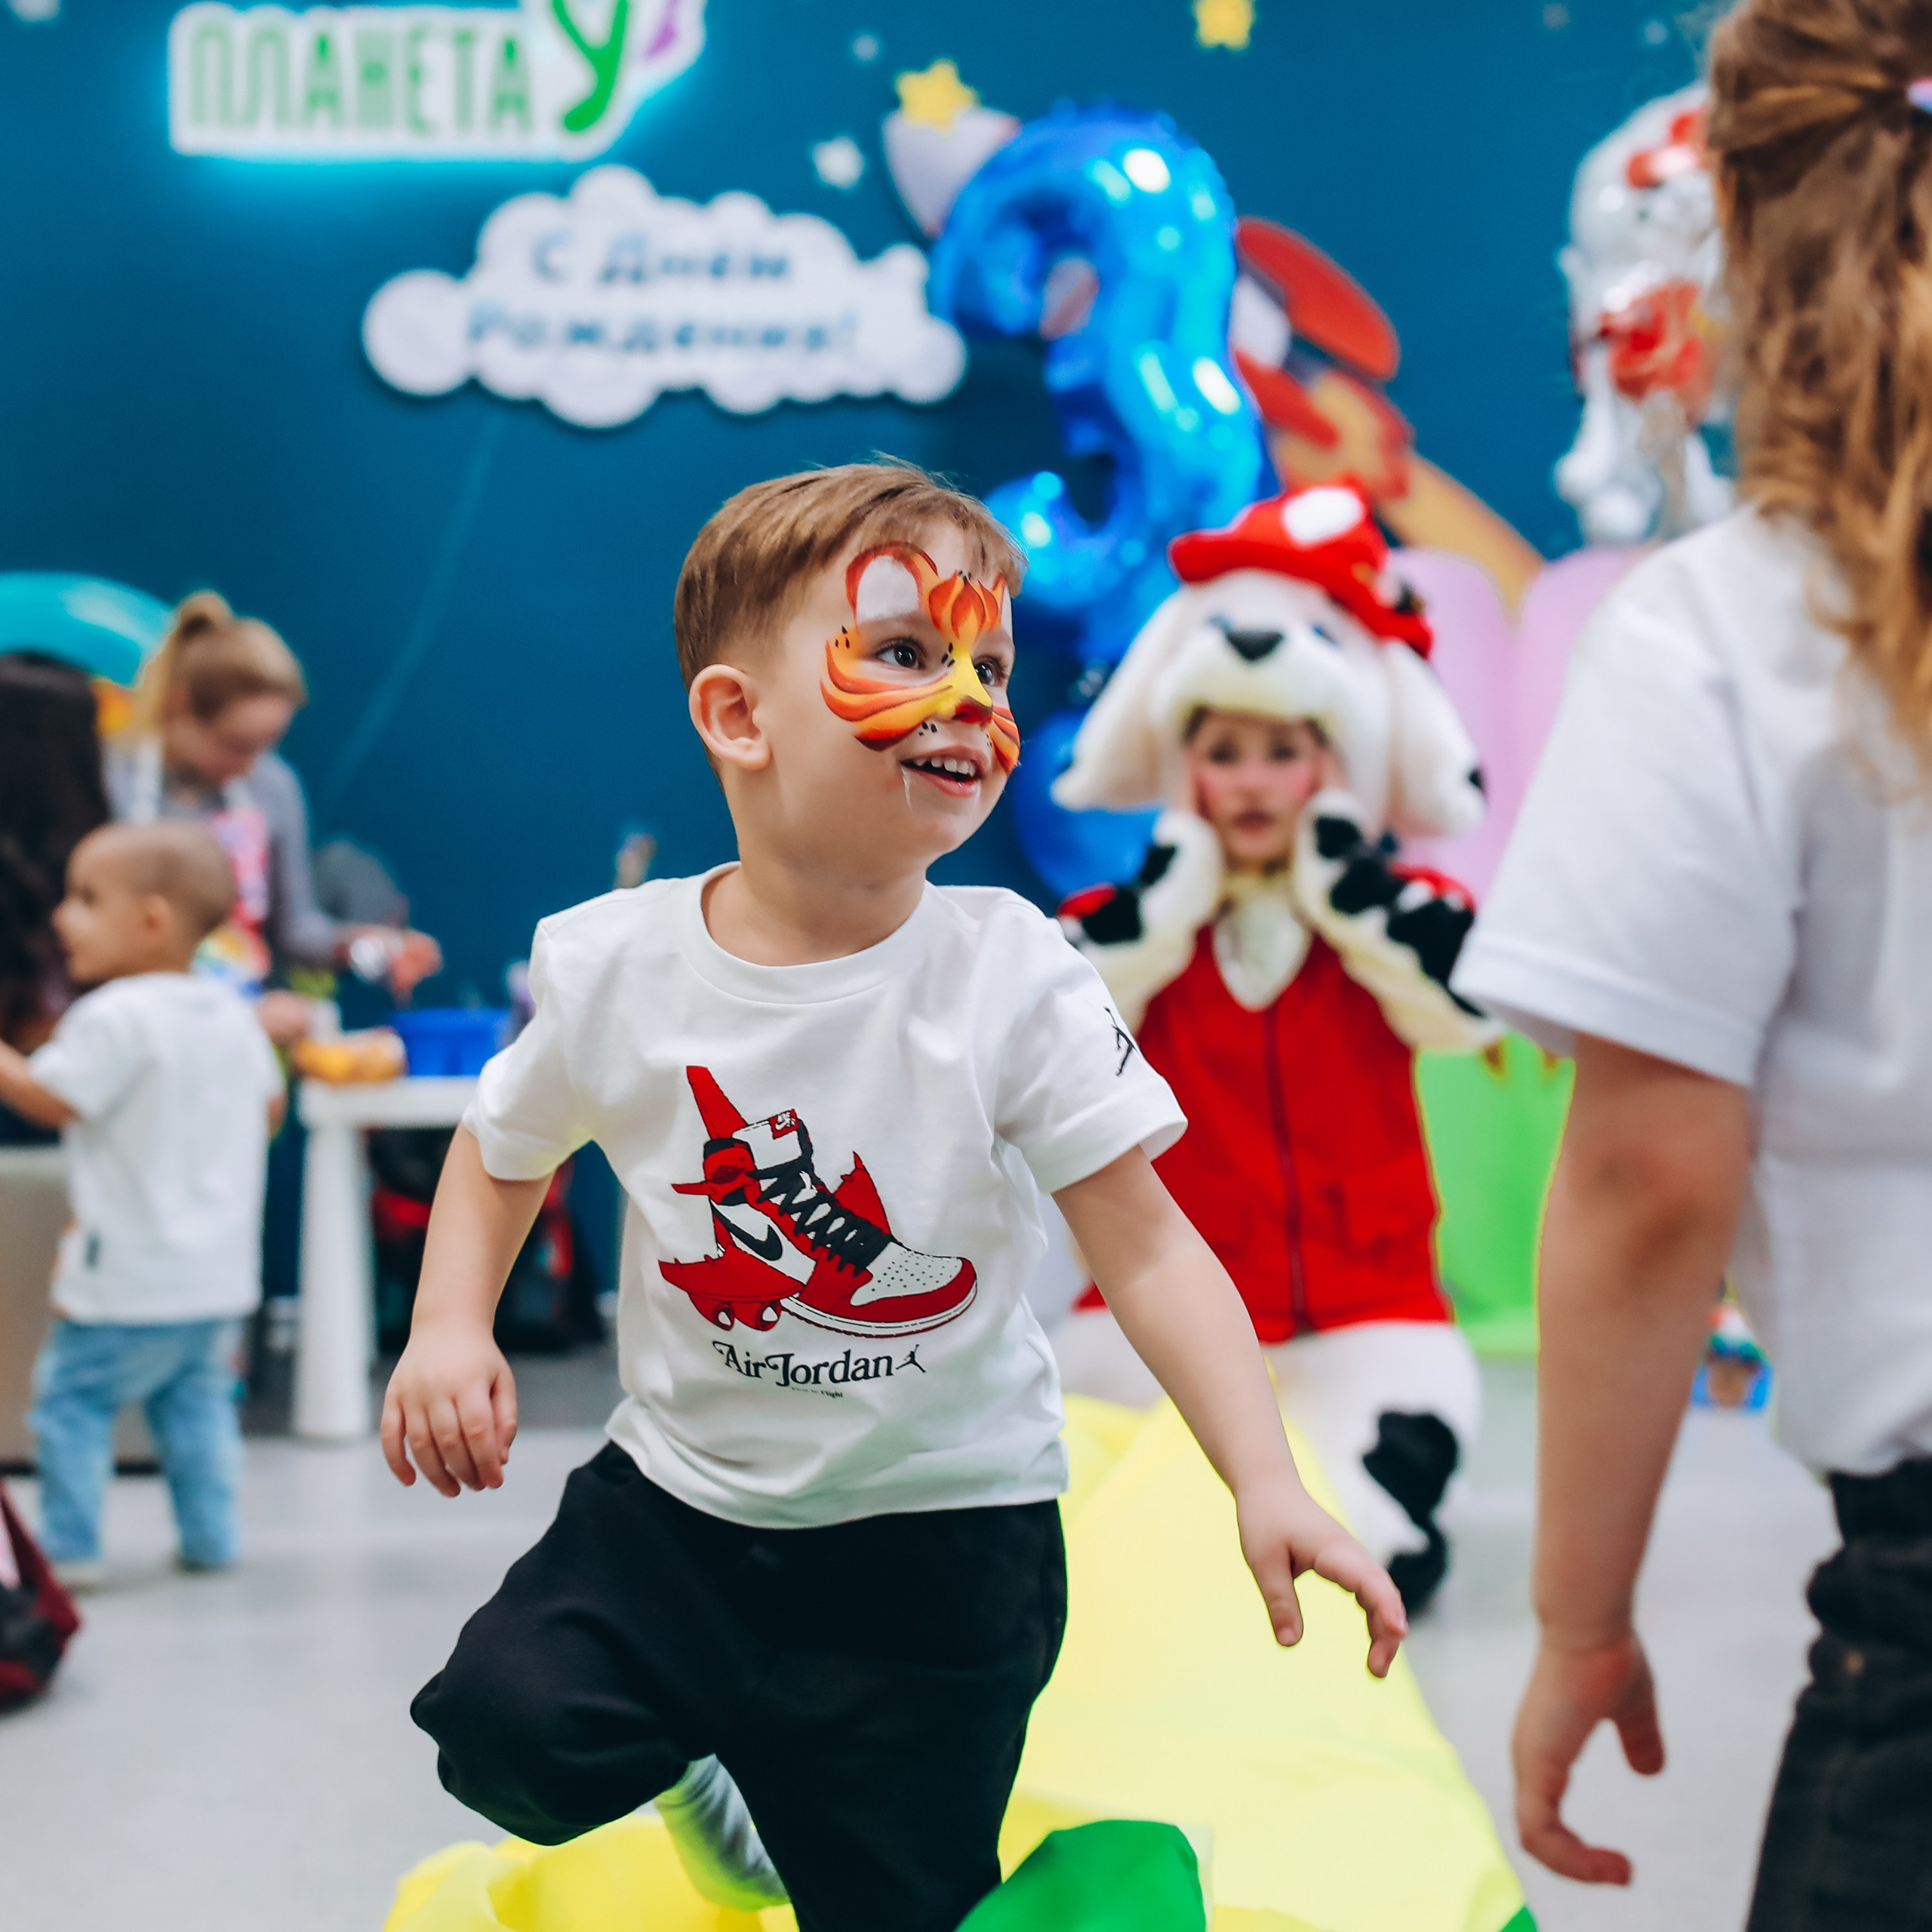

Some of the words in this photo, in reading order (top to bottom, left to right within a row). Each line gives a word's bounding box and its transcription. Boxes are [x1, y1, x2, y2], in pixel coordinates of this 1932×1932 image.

[190, 26, 533, 131] ПЛАНЕТА
[712, 1340, 765, 1379] Air
[764, 1349, 894, 1387] Jordan
